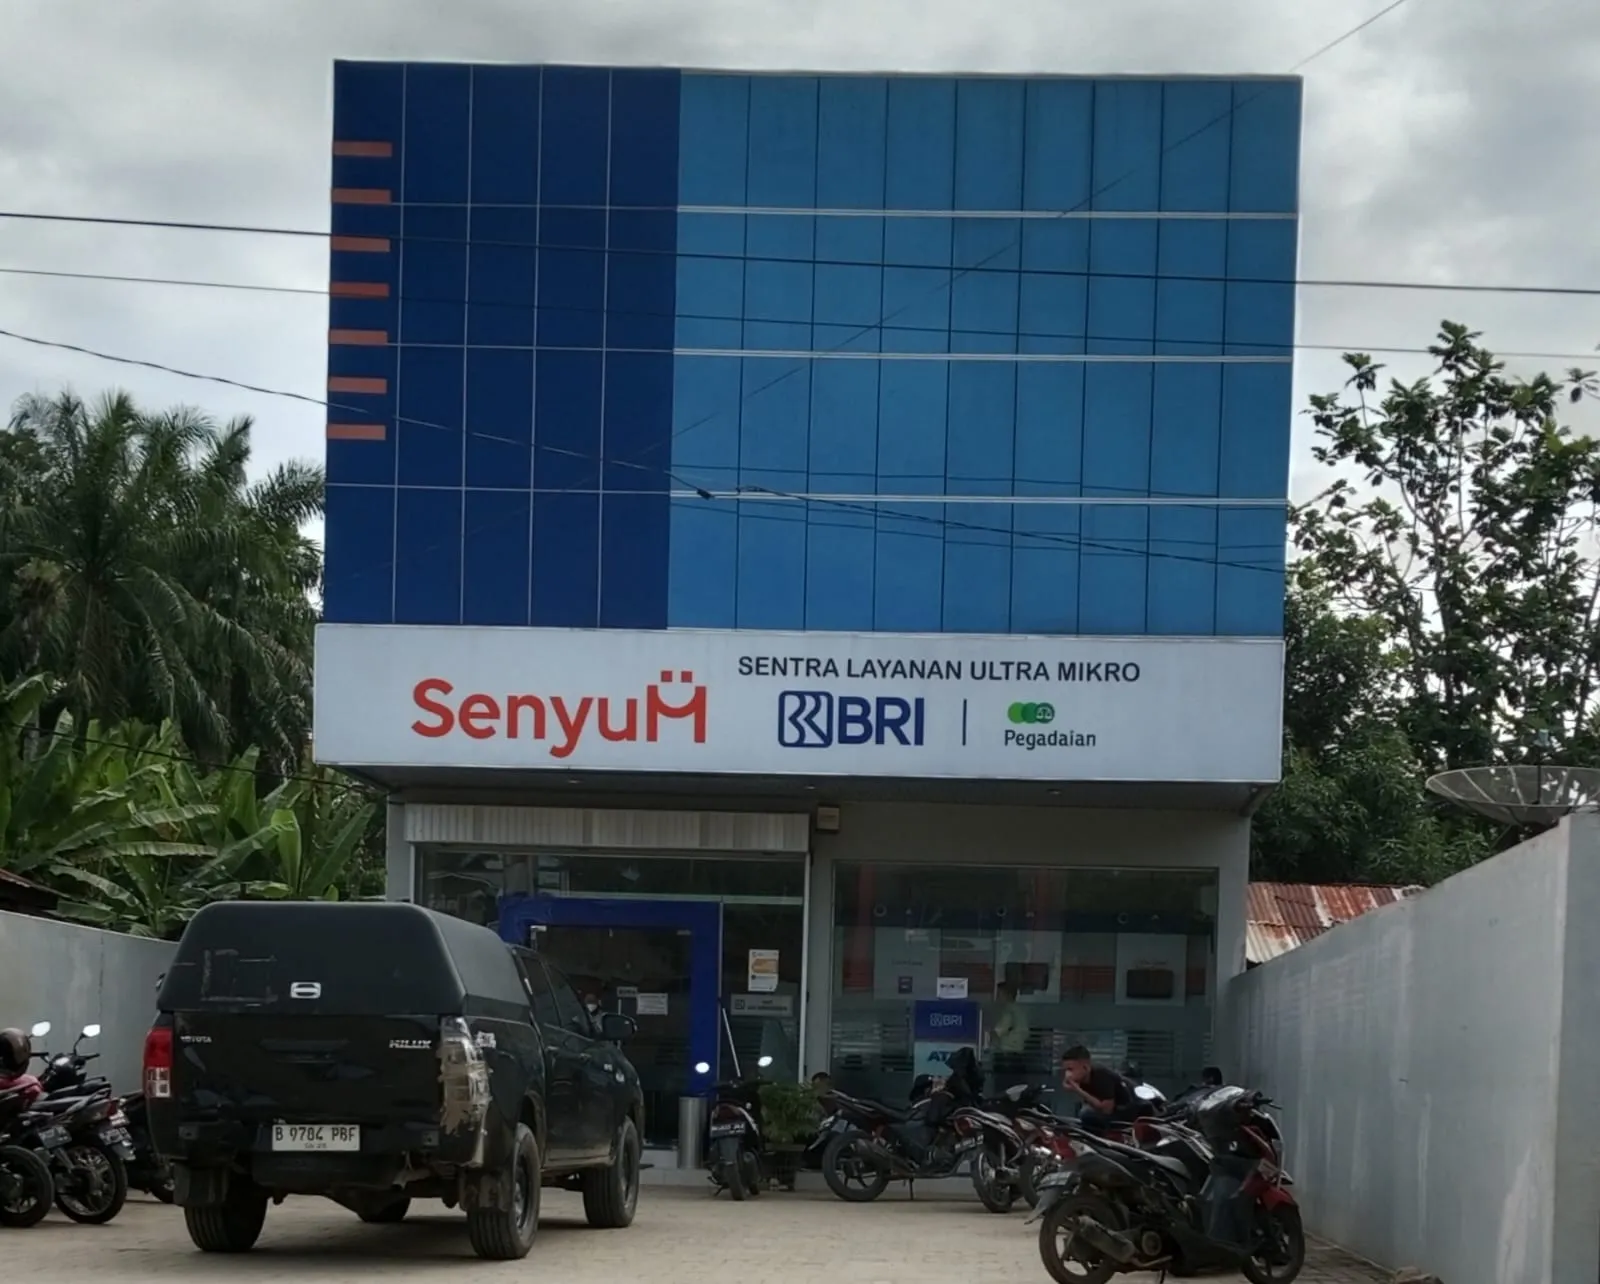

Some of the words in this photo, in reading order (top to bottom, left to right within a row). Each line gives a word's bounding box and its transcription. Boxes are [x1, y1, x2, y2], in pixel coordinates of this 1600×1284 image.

[738, 656, 840, 679] SENTRA
[847, 658, 962, 681] LAYANAN
[970, 660, 1050, 682] ULTRA
[1058, 661, 1140, 683] MIKRO
[837, 696, 925, 747] BRI
[1003, 729, 1097, 751] Pegadaian
[942, 1015, 962, 1026] BRI
[389, 1039, 432, 1049] HILUX
[275, 1127, 284, 1141] B
[331, 1127, 357, 1142] PBF
